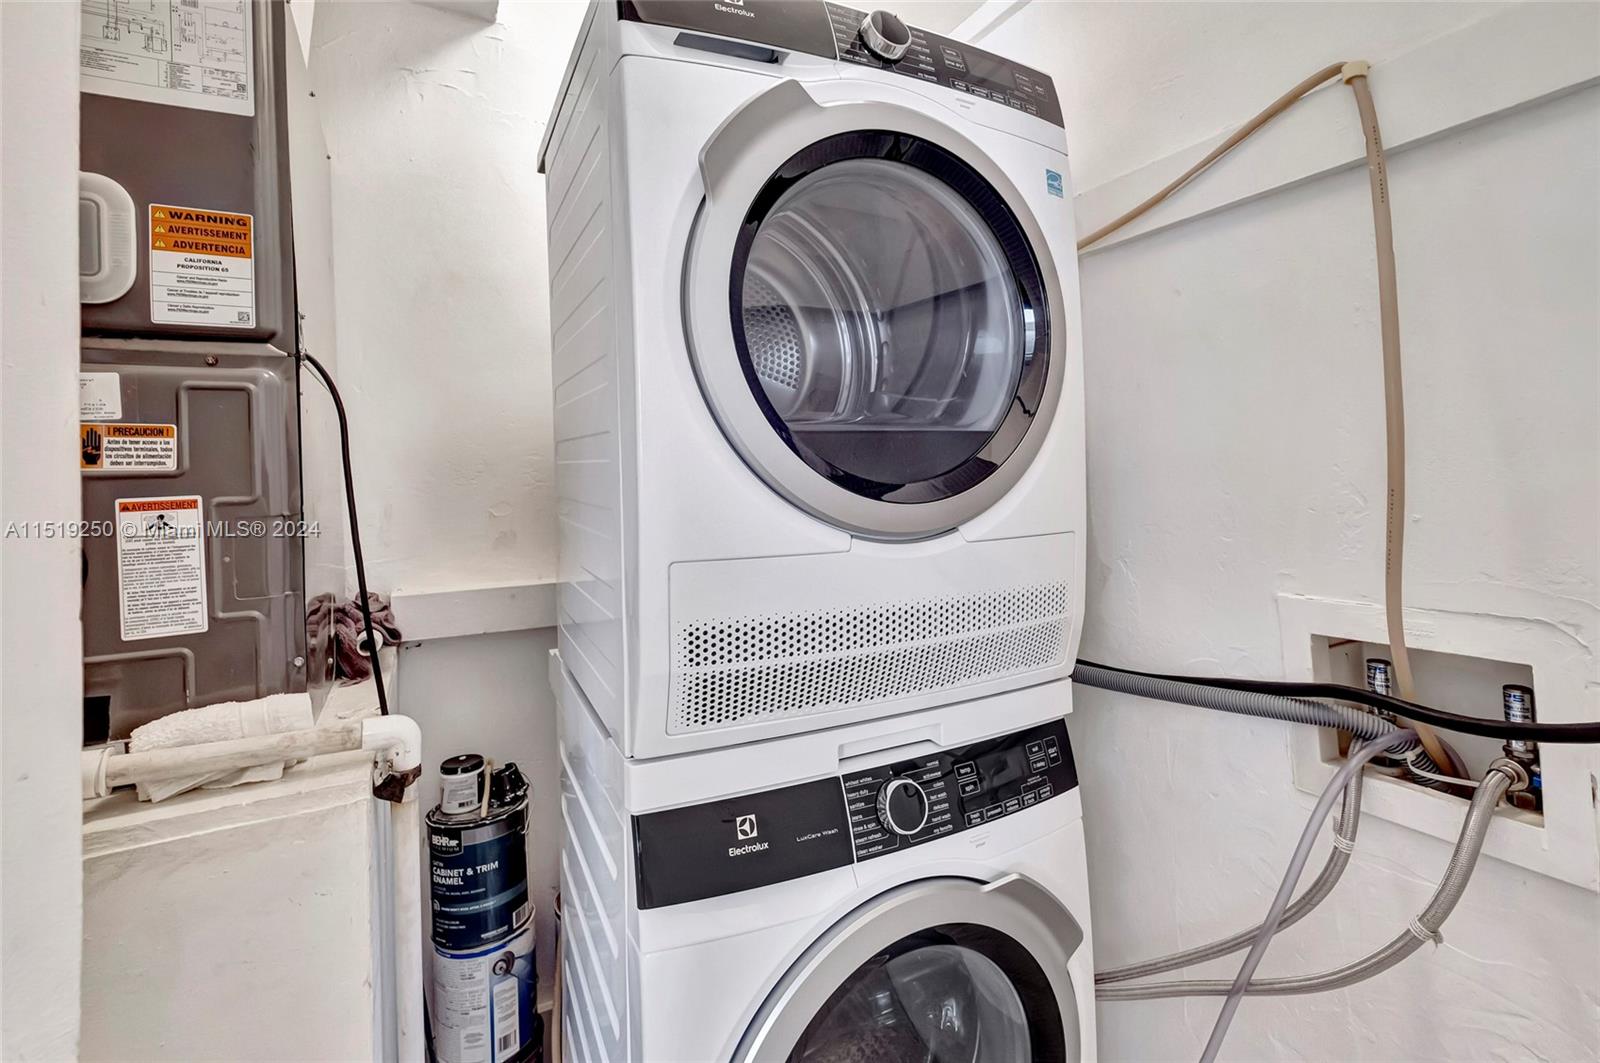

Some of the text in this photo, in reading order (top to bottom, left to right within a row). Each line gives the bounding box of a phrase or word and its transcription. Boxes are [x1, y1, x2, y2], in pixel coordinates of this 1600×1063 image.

[714, 3, 755, 18] Electrolux
[168, 210, 247, 226] WARNING
[168, 225, 248, 240] AVERTISSEMENT
[173, 240, 246, 254] ADVERTENCIA
[177, 264, 220, 272] PROPOSITION
[112, 427, 164, 436] PRECAUCION
[131, 500, 196, 511] AVERTISSEMENT
[432, 834, 450, 846] BEHR
[796, 833, 821, 842] LuxCare
[729, 842, 768, 856] Electrolux
[433, 866, 464, 877] CABINET
[476, 860, 498, 874] TRIM
[433, 875, 464, 885] ENAMEL
